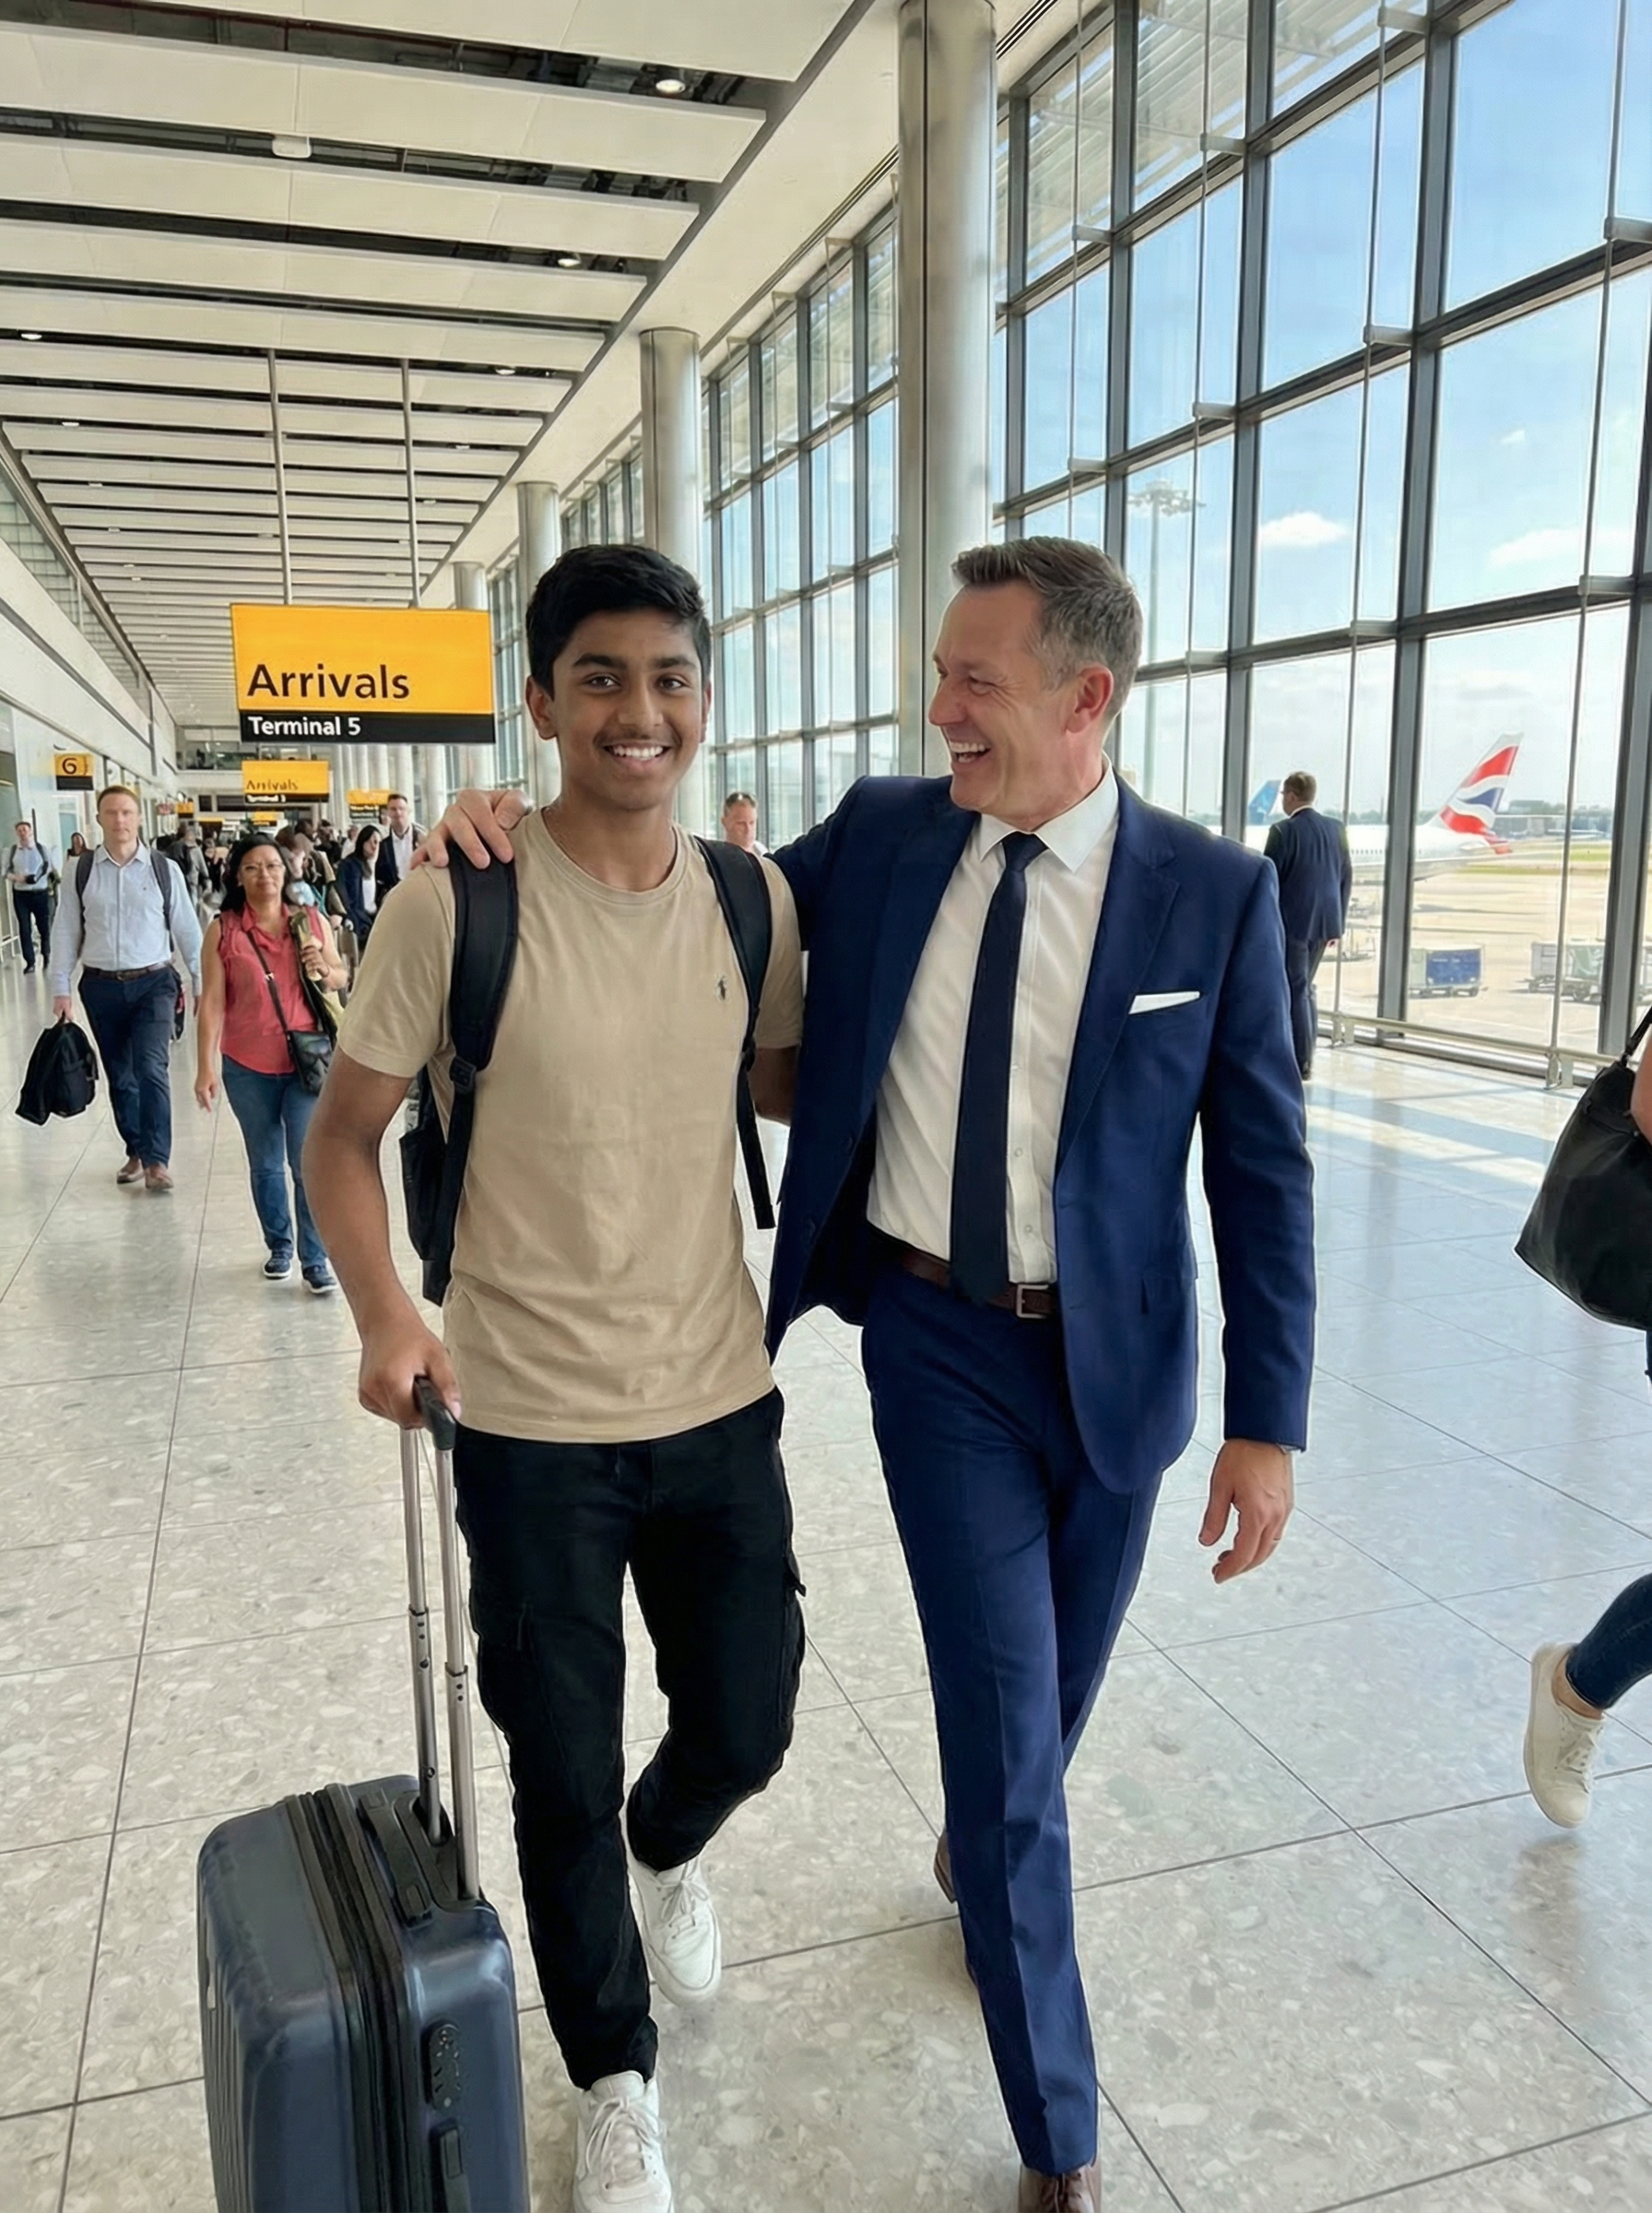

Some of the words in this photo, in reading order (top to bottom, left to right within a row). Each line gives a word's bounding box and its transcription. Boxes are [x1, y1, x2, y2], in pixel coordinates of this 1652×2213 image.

[246, 663, 410, 699] Arrivals
[247, 716, 341, 736] Terminal
[348, 716, 361, 736] 5
